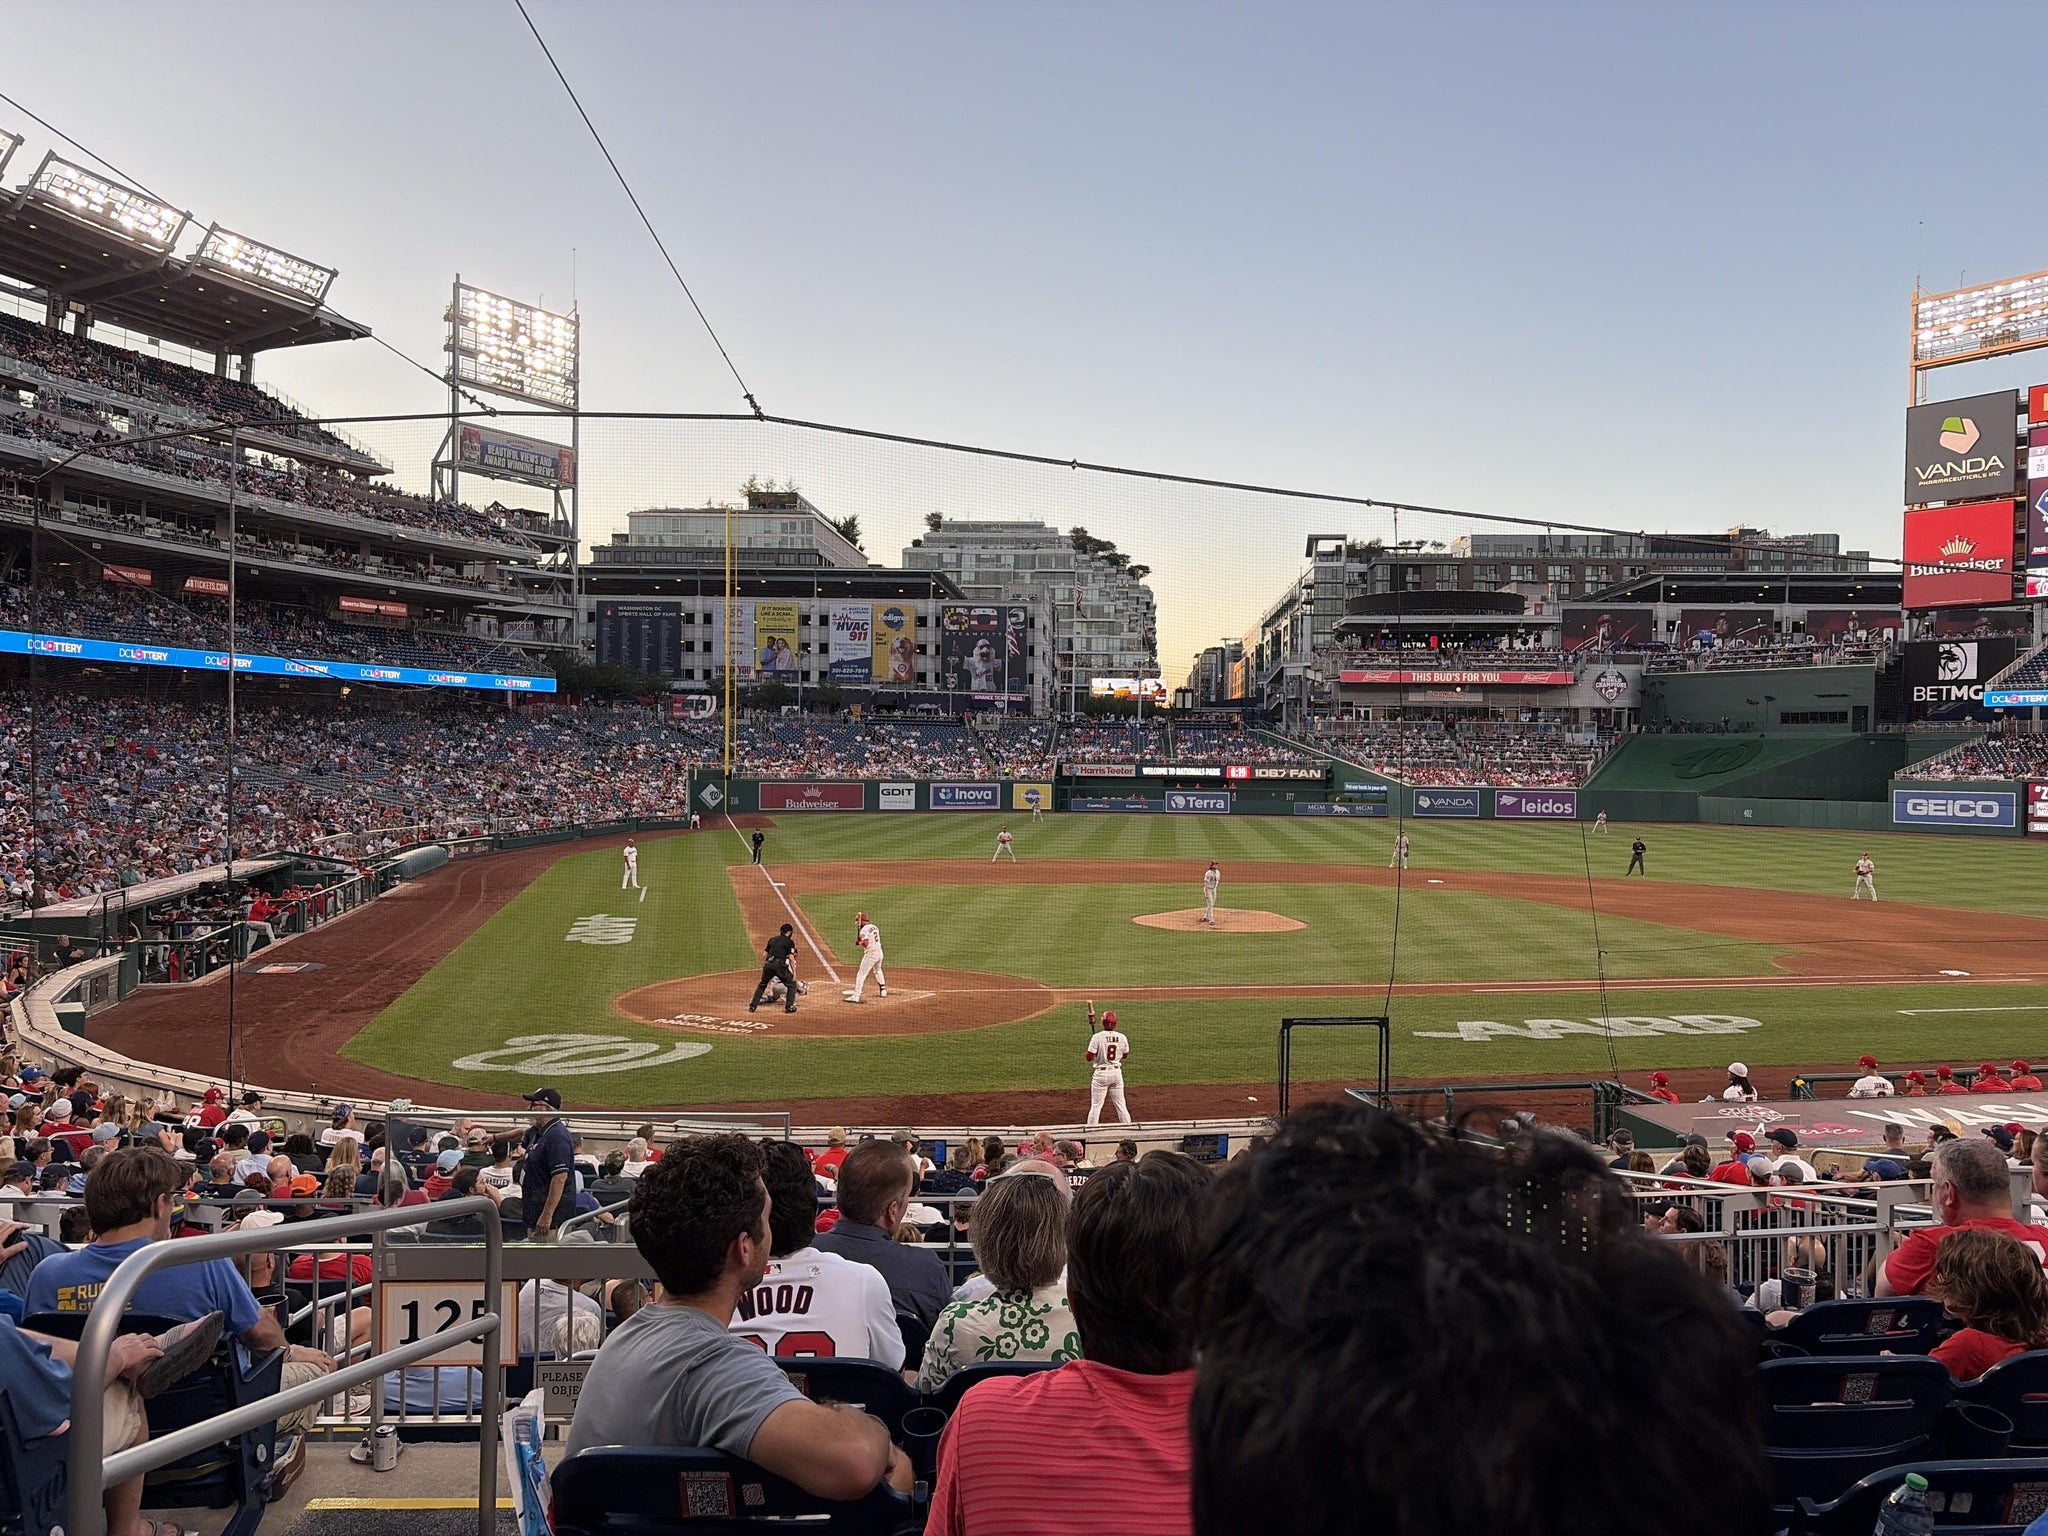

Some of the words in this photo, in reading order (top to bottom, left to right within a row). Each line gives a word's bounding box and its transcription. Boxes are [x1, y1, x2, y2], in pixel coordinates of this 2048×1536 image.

[487, 445, 519, 460] BEAUTIFUL
[520, 450, 539, 463] VIEWS
[539, 456, 552, 466] AND
[483, 454, 506, 468] AWARD
[507, 459, 534, 474] WINNING
[534, 464, 555, 478] BREWS
[1914, 455, 2005, 479] VANDA
[1918, 473, 1988, 486] PHARMACEUTICALS
[1909, 557, 2004, 577] Budweiser
[877, 613, 909, 623] Pedigree
[836, 621, 870, 631] HVAC
[849, 631, 868, 641] 911
[1412, 672, 1432, 681] THIS
[1433, 673, 1460, 682] BUD'S
[1462, 673, 1480, 682] FOR
[1482, 673, 1502, 682] YOU.
[1913, 685, 1984, 702] BETMG
[1080, 766, 1106, 774] Harris
[1106, 767, 1133, 775] Teeter
[1142, 767, 1168, 775] WELCOME
[1168, 767, 1176, 775] TO
[1176, 767, 1205, 776] NATIONALS
[1205, 768, 1221, 776] PARK
[1289, 769, 1321, 778] FAN
[881, 788, 914, 796] GDIT
[955, 788, 992, 800] Inova
[1187, 797, 1225, 809] Terra
[1431, 798, 1474, 806] VANDA
[1521, 799, 1573, 814] leidos
[1907, 798, 2000, 818] GEICO
[674, 1013, 722, 1022] VOTE
[721, 1020, 775, 1030] NATS
[1412, 1014, 1763, 1041] AARP
[1106, 1044, 1117, 1061] 8
[737, 1284, 814, 1322] WOOD
[542, 1372, 582, 1382] PLEASE
[552, 1385, 582, 1396] OBJE
